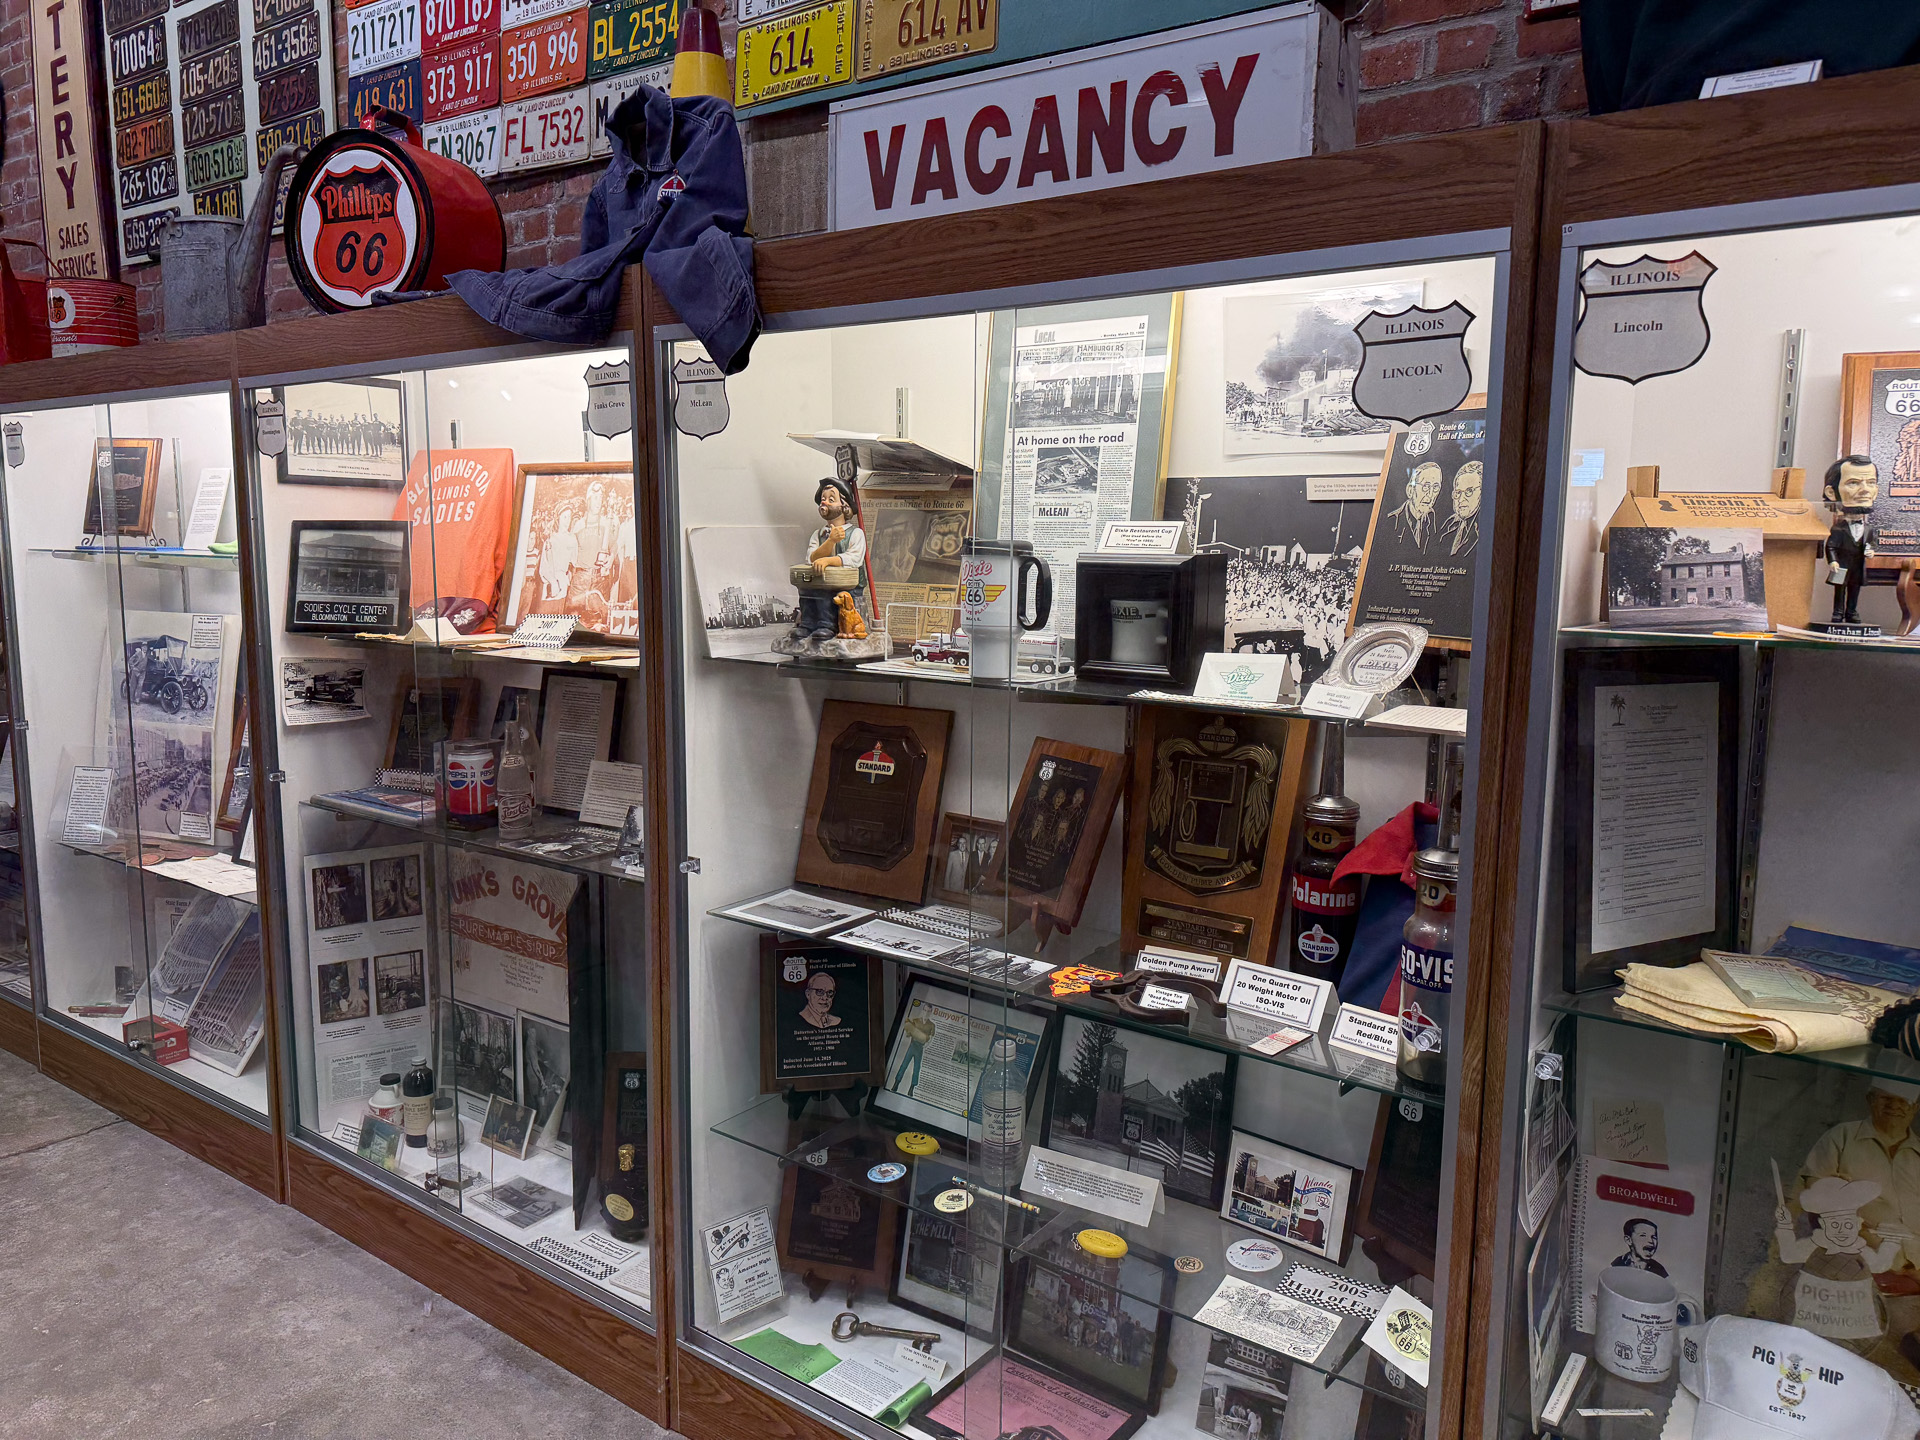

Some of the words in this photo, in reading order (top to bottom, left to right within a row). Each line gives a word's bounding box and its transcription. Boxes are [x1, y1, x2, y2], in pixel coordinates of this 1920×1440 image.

[425, 0, 456, 37] 870
[777, 14, 809, 31] ILLINOIS
[899, 0, 947, 48] 614
[956, 0, 989, 36] AV
[350, 4, 416, 61] 2117217
[593, 15, 623, 62] BL
[628, 0, 680, 53] 2554
[834, 2, 846, 74] VEHICLE
[862, 1, 874, 71] ANTIQUE
[114, 28, 155, 79] 70064
[254, 24, 309, 73] 461-358
[372, 50, 395, 64] ILLINOIS
[448, 48, 471, 61] ILLINOIS
[507, 40, 537, 82] 350
[547, 27, 579, 71] 996
[769, 26, 815, 76] 614
[904, 45, 941, 65] ILLINOIS
[612, 57, 628, 67] LAND
[741, 31, 752, 98] ANTIQUE
[426, 64, 456, 105] 373
[464, 52, 493, 94] 917
[529, 75, 553, 89] ILLINOIS
[623, 75, 650, 88] ILLINOIS
[651, 71, 660, 81] 67
[761, 84, 779, 98] LAND
[780, 82, 791, 92] OF
[790, 72, 821, 90] LINCOLN
[114, 81, 161, 122] 191-660
[388, 75, 414, 113] 631
[504, 115, 534, 157] FL
[538, 105, 585, 150] 7532
[863, 52, 1261, 212] VACANCY
[121, 161, 168, 204] 265-182
[320, 181, 393, 224] Phillips
[58, 221, 90, 250] SALES
[1562, 225, 1573, 234] 10
[335, 230, 388, 278] 66
[57, 252, 98, 278] SERVICE
[1610, 269, 1681, 286] ILLINOIS
[1384, 318, 1445, 335] ILLINOIS
[1613, 320, 1663, 334] Lincoln
[594, 371, 621, 381] ILLINOIS
[686, 368, 716, 377] ILLINOIS
[1382, 363, 1444, 380] LINCOLN
[689, 399, 713, 408] McLean
[1896, 399, 1920, 414] 66
[1439, 423, 1458, 431] Route
[1457, 422, 1466, 430] 66
[1017, 436, 1028, 446] At
[1031, 433, 1059, 445] home
[1062, 435, 1076, 444] on
[1078, 433, 1096, 444] the
[1098, 431, 1124, 443] road
[1437, 432, 1450, 440] Hall
[1457, 432, 1475, 440] Fame
[1409, 439, 1426, 451] 66
[839, 463, 853, 480] 66
[406, 457, 492, 507] BLOOMINGTON
[425, 484, 471, 503] ILLINOIS
[900, 499, 923, 508] shrine
[923, 499, 931, 508] to
[932, 499, 954, 509] Route
[955, 500, 965, 509] 66
[1755, 499, 1770, 507] IL
[412, 500, 476, 527] SODIES
[1038, 507, 1070, 517] McLEAN
[1690, 510, 1779, 518] 1853-2003
[1878, 528, 1917, 537] Inducted
[1878, 538, 1904, 546] Route
[962, 559, 993, 582] Dixie
[1401, 565, 1422, 573] Walters
[1433, 566, 1448, 575] John
[966, 588, 982, 603] 66
[303, 602, 332, 613] SODIE'S
[334, 603, 357, 614] CYCLE
[359, 604, 388, 616] CENTER
[311, 614, 348, 623] BLOOMINGTON
[355, 615, 378, 624] ILLINOIS
[537, 618, 558, 630] 2007
[514, 630, 531, 642] Hall
[532, 631, 541, 641] of
[541, 632, 565, 643] Fame
[1826, 626, 1862, 636] Abraham
[1365, 660, 1399, 669] DIXIE
[1198, 733, 1236, 743] STANDARD
[448, 770, 468, 779] PEPSI
[857, 761, 892, 774] STANDARD
[1041, 769, 1050, 778] 66
[1311, 831, 1332, 845] 40
[1159, 858, 1190, 883] GOLDEN
[1190, 876, 1213, 887] PUMP
[1215, 870, 1242, 886] AWARD
[1292, 876, 1356, 908] Polarine
[1420, 882, 1440, 900] 20
[1166, 918, 1205, 932] STANDARD
[1205, 925, 1219, 935] OIL
[459, 918, 486, 938] PURE
[487, 926, 522, 951] MAPLE
[526, 940, 556, 958] SIRUP
[1301, 941, 1334, 953] STANDARD
[1141, 956, 1168, 967] Golden
[1168, 961, 1189, 970] Pump
[1190, 964, 1215, 974] Award
[1719, 955, 1753, 966] GUEST
[1755, 959, 1788, 969] CHECK
[788, 970, 802, 980] 66
[1251, 974, 1267, 984] One
[1268, 978, 1291, 990] Quart
[1292, 984, 1302, 992] Of
[1248, 983, 1274, 996] Weight
[1275, 990, 1299, 1002] Motor
[1299, 997, 1312, 1006] Oil
[1255, 996, 1285, 1009] ISO-VIS
[932, 1006, 966, 1024] Bunyon's
[1348, 1015, 1386, 1032] Standard
[1356, 1029, 1393, 1046] Red/Blue
[627, 1079, 638, 1088] 66
[1403, 1104, 1418, 1119] 66
[1127, 1129, 1138, 1139] 66
[810, 1152, 824, 1164] 66
[1608, 1185, 1678, 1207] BROADWELL
[1240, 1201, 1268, 1218] ATLANTA
[915, 1221, 929, 1237] THE
[930, 1222, 955, 1244] MILL
[744, 1275, 756, 1285] THE
[1286, 1279, 1325, 1298] Hall
[1327, 1294, 1348, 1305] of
[1327, 1280, 1370, 1299] 2005
[1801, 1284, 1866, 1304] PIG-HIP
[1081, 1303, 1095, 1315] 66
[1621, 1313, 1655, 1325] Restaurant
[1796, 1309, 1875, 1328] SANDWICHES
[1399, 1337, 1413, 1350] 66
[1751, 1345, 1776, 1366] PIG
[1818, 1366, 1845, 1386] HIP
[1388, 1370, 1400, 1386] 66
[1004, 1365, 1047, 1388] Certificate
[1059, 1388, 1111, 1419] Authenticity
[1769, 1404, 1786, 1415] EST.
[1788, 1411, 1807, 1422] 1937
